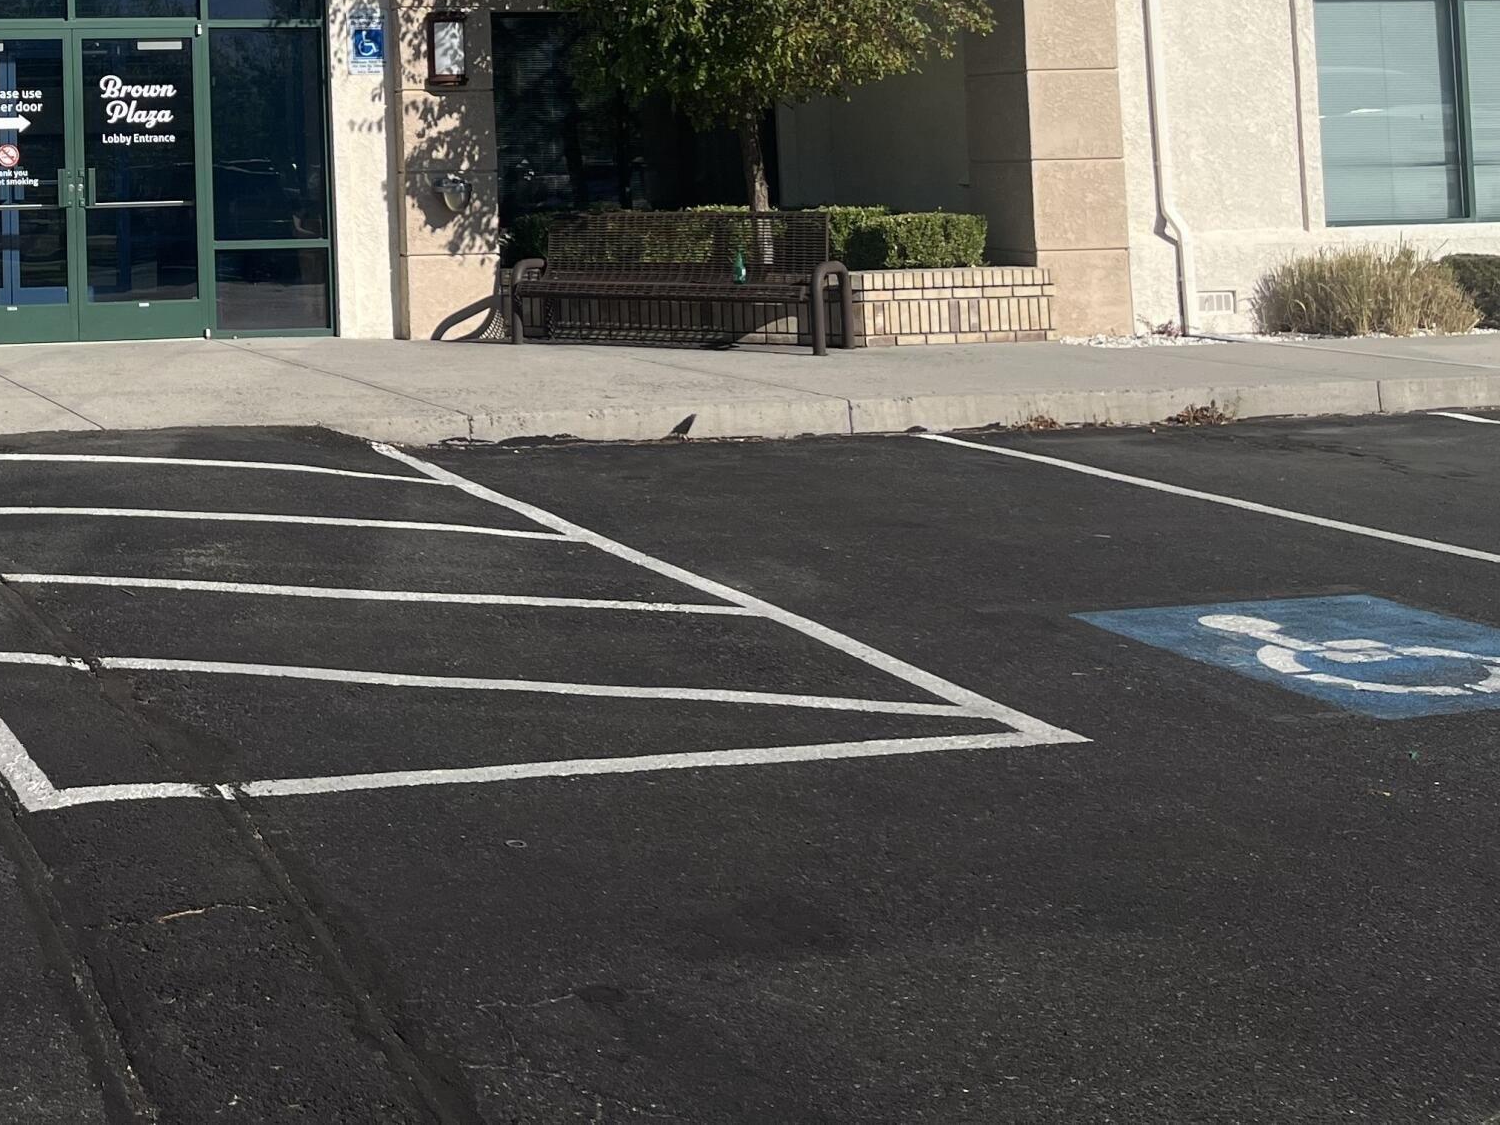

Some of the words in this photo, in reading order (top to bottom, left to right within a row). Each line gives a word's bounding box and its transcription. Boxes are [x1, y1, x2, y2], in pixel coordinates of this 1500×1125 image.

[99, 74, 177, 98] Brown
[21, 90, 42, 98] use
[15, 101, 43, 112] door
[106, 100, 174, 128] Plaza
[102, 133, 131, 145] Lobby
[133, 133, 176, 142] Entrance
[13, 170, 28, 178] you
[6, 177, 39, 187] smoking
